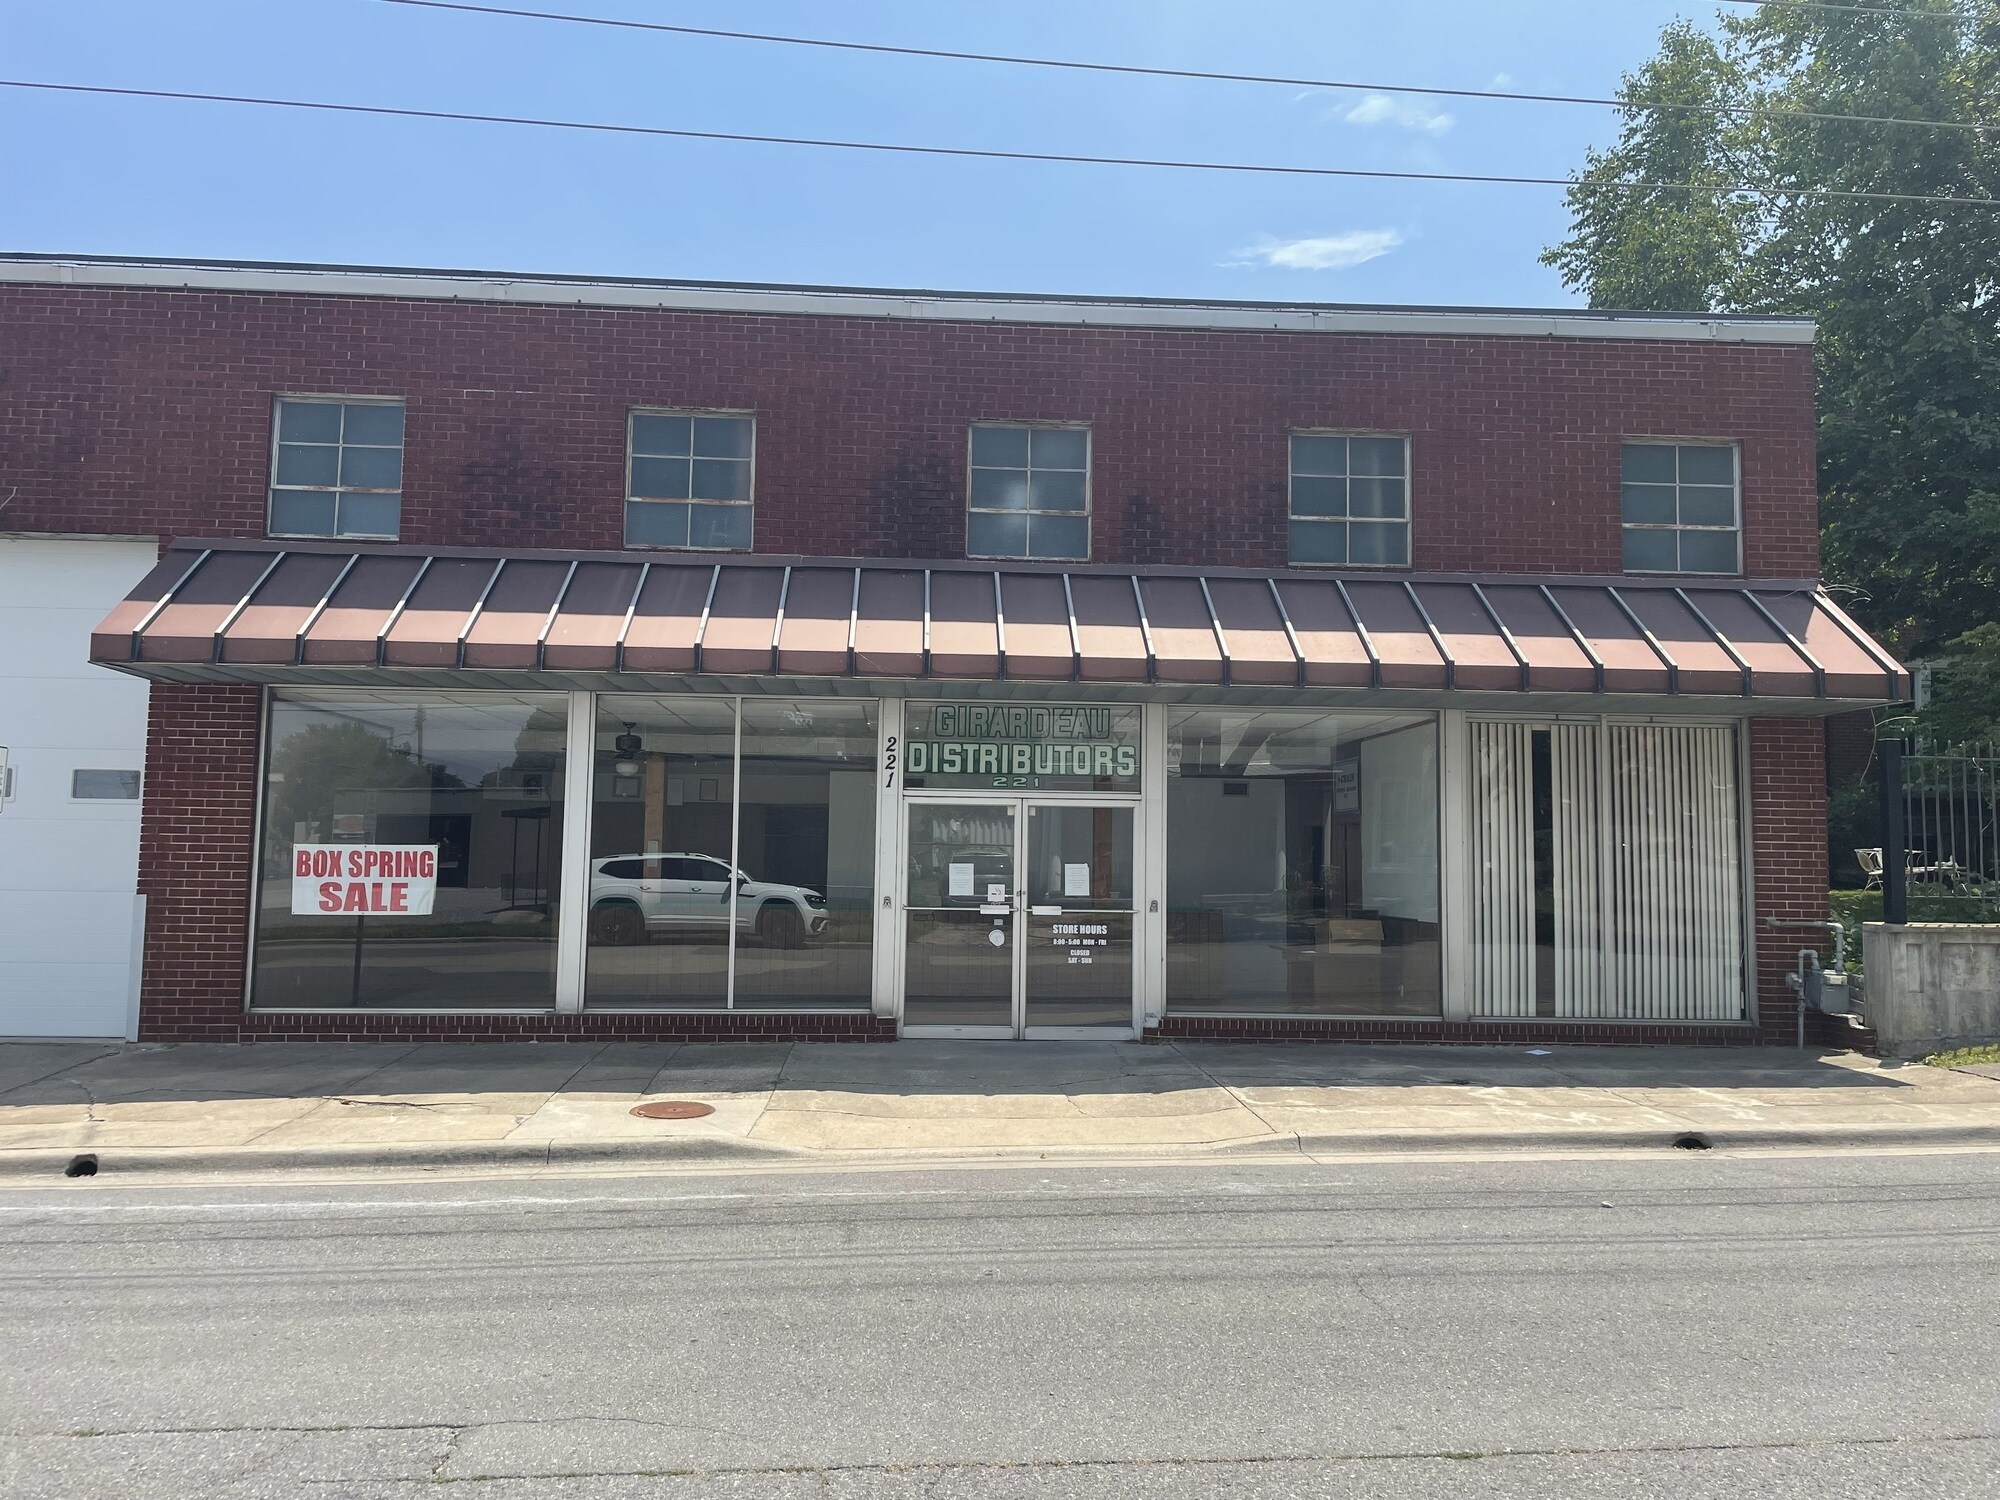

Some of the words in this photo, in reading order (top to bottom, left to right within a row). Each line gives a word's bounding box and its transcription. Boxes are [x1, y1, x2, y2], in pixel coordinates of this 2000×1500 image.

[935, 705, 1111, 739] GIRARDEAU
[885, 736, 897, 788] 221
[907, 741, 1137, 776] DISTRIBUTORS
[992, 776, 1039, 788] 221
[296, 850, 343, 878] BOX
[348, 850, 434, 878] SPRING
[318, 881, 409, 912] SALE
[1052, 924, 1079, 934] STORE
[1079, 924, 1108, 935] HOURS
[1082, 938, 1095, 946] MON
[1098, 938, 1107, 946] FRI
